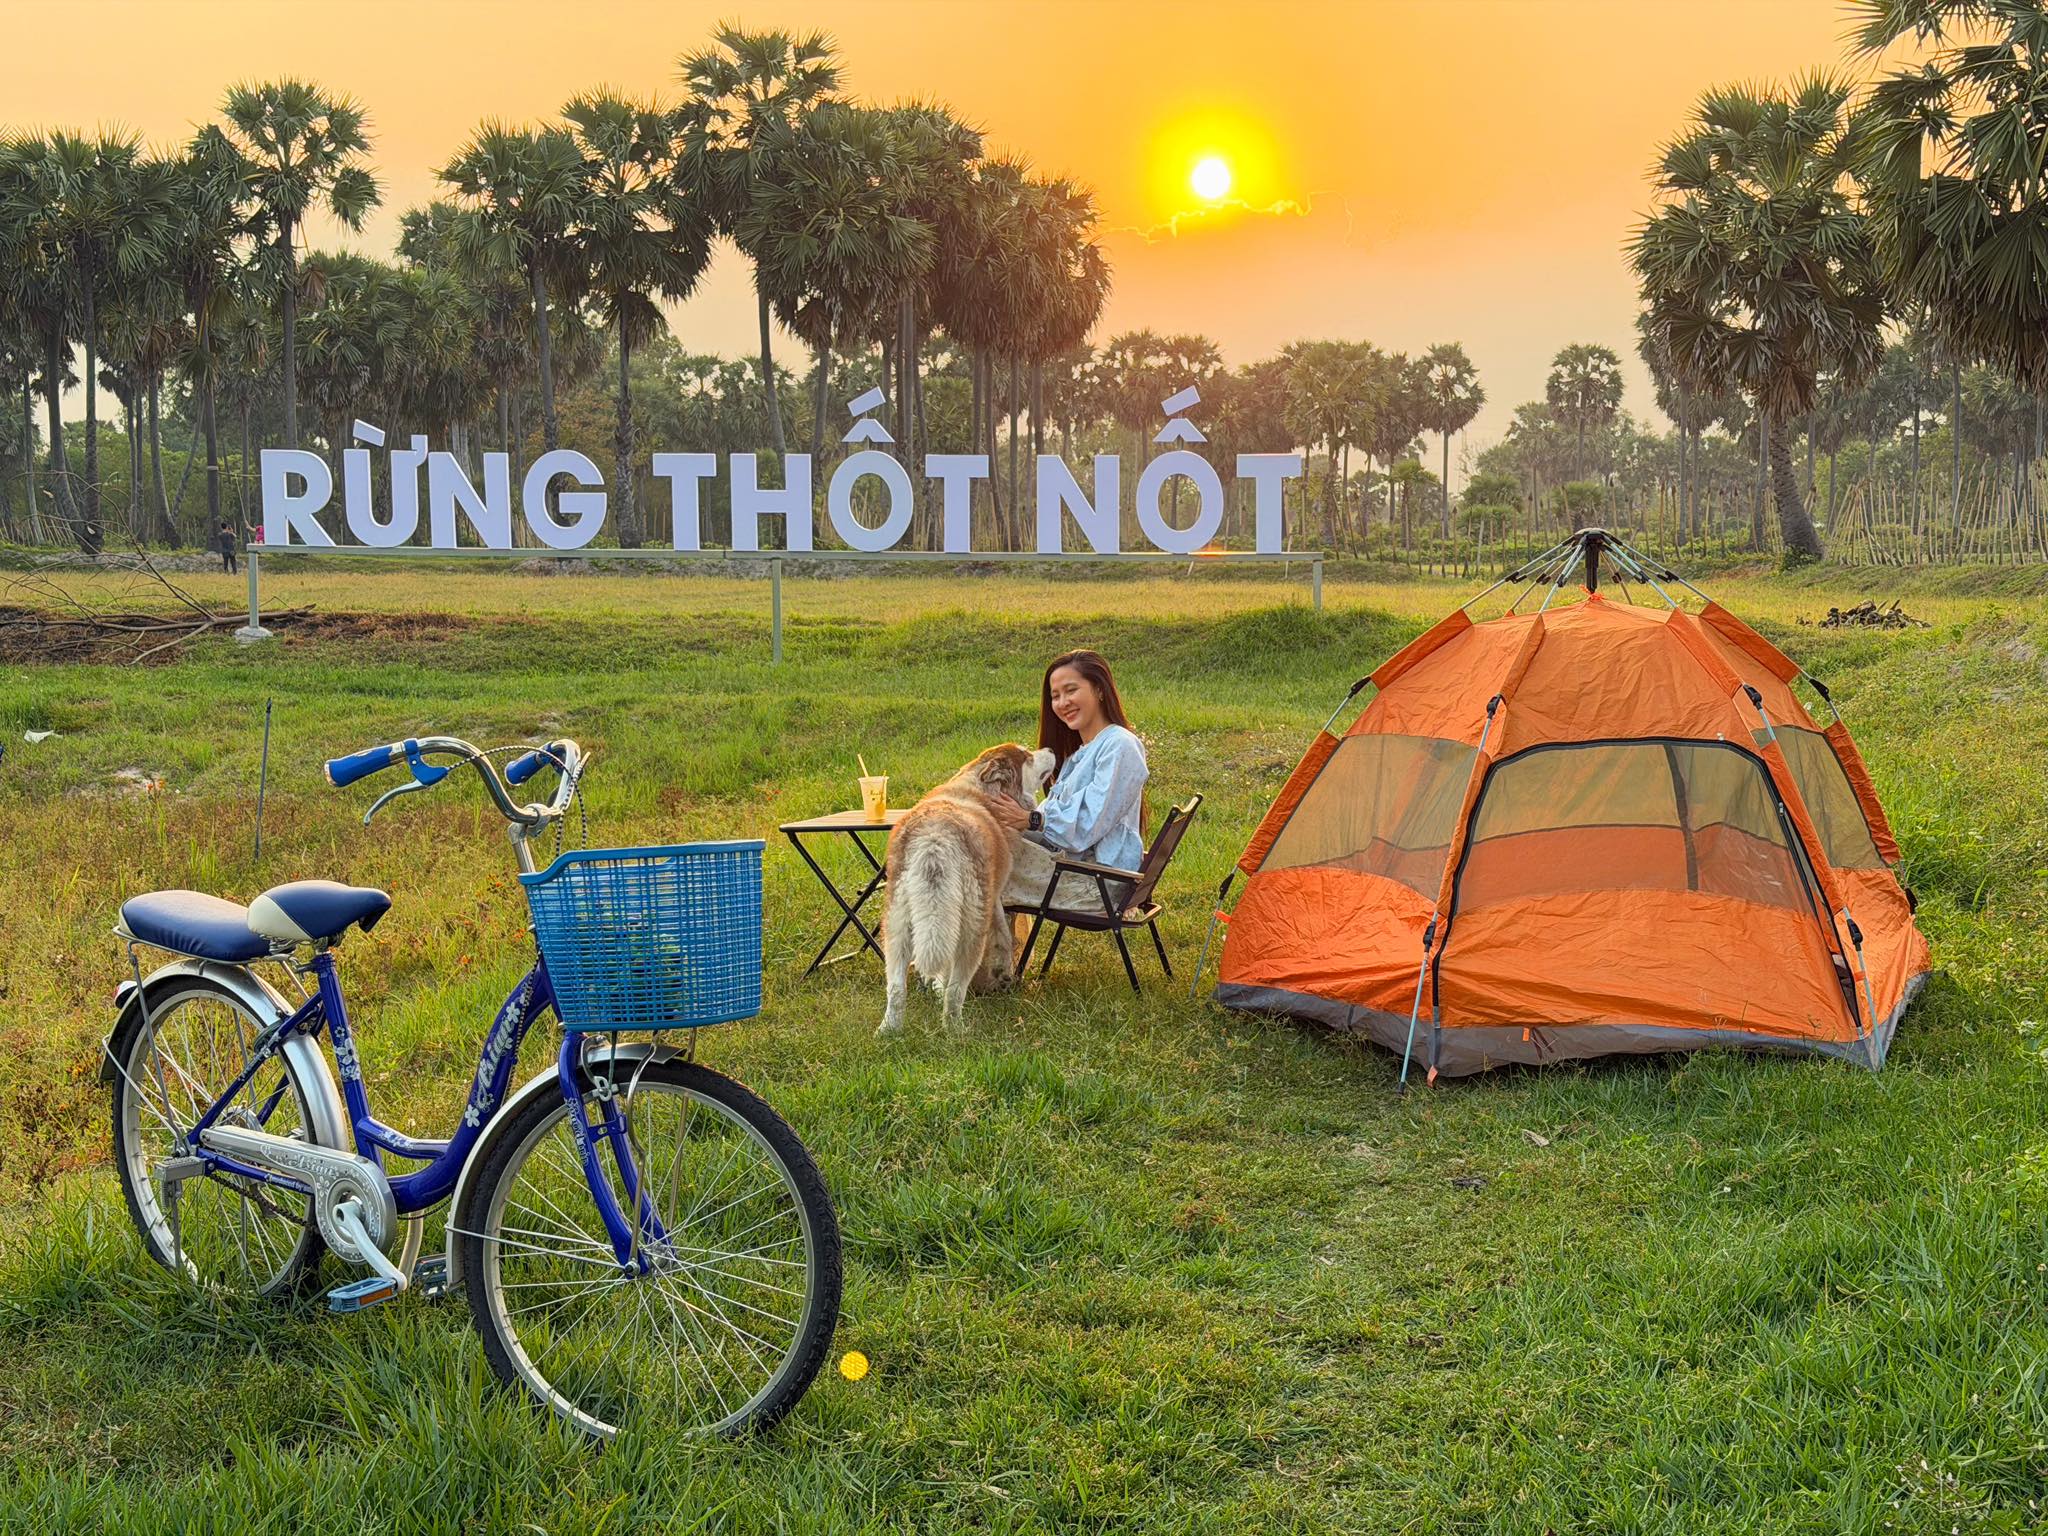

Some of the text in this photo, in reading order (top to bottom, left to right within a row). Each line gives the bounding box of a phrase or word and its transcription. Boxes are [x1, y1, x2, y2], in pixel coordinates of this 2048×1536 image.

[260, 386, 1304, 555] RỪNG THỐT NỐT
